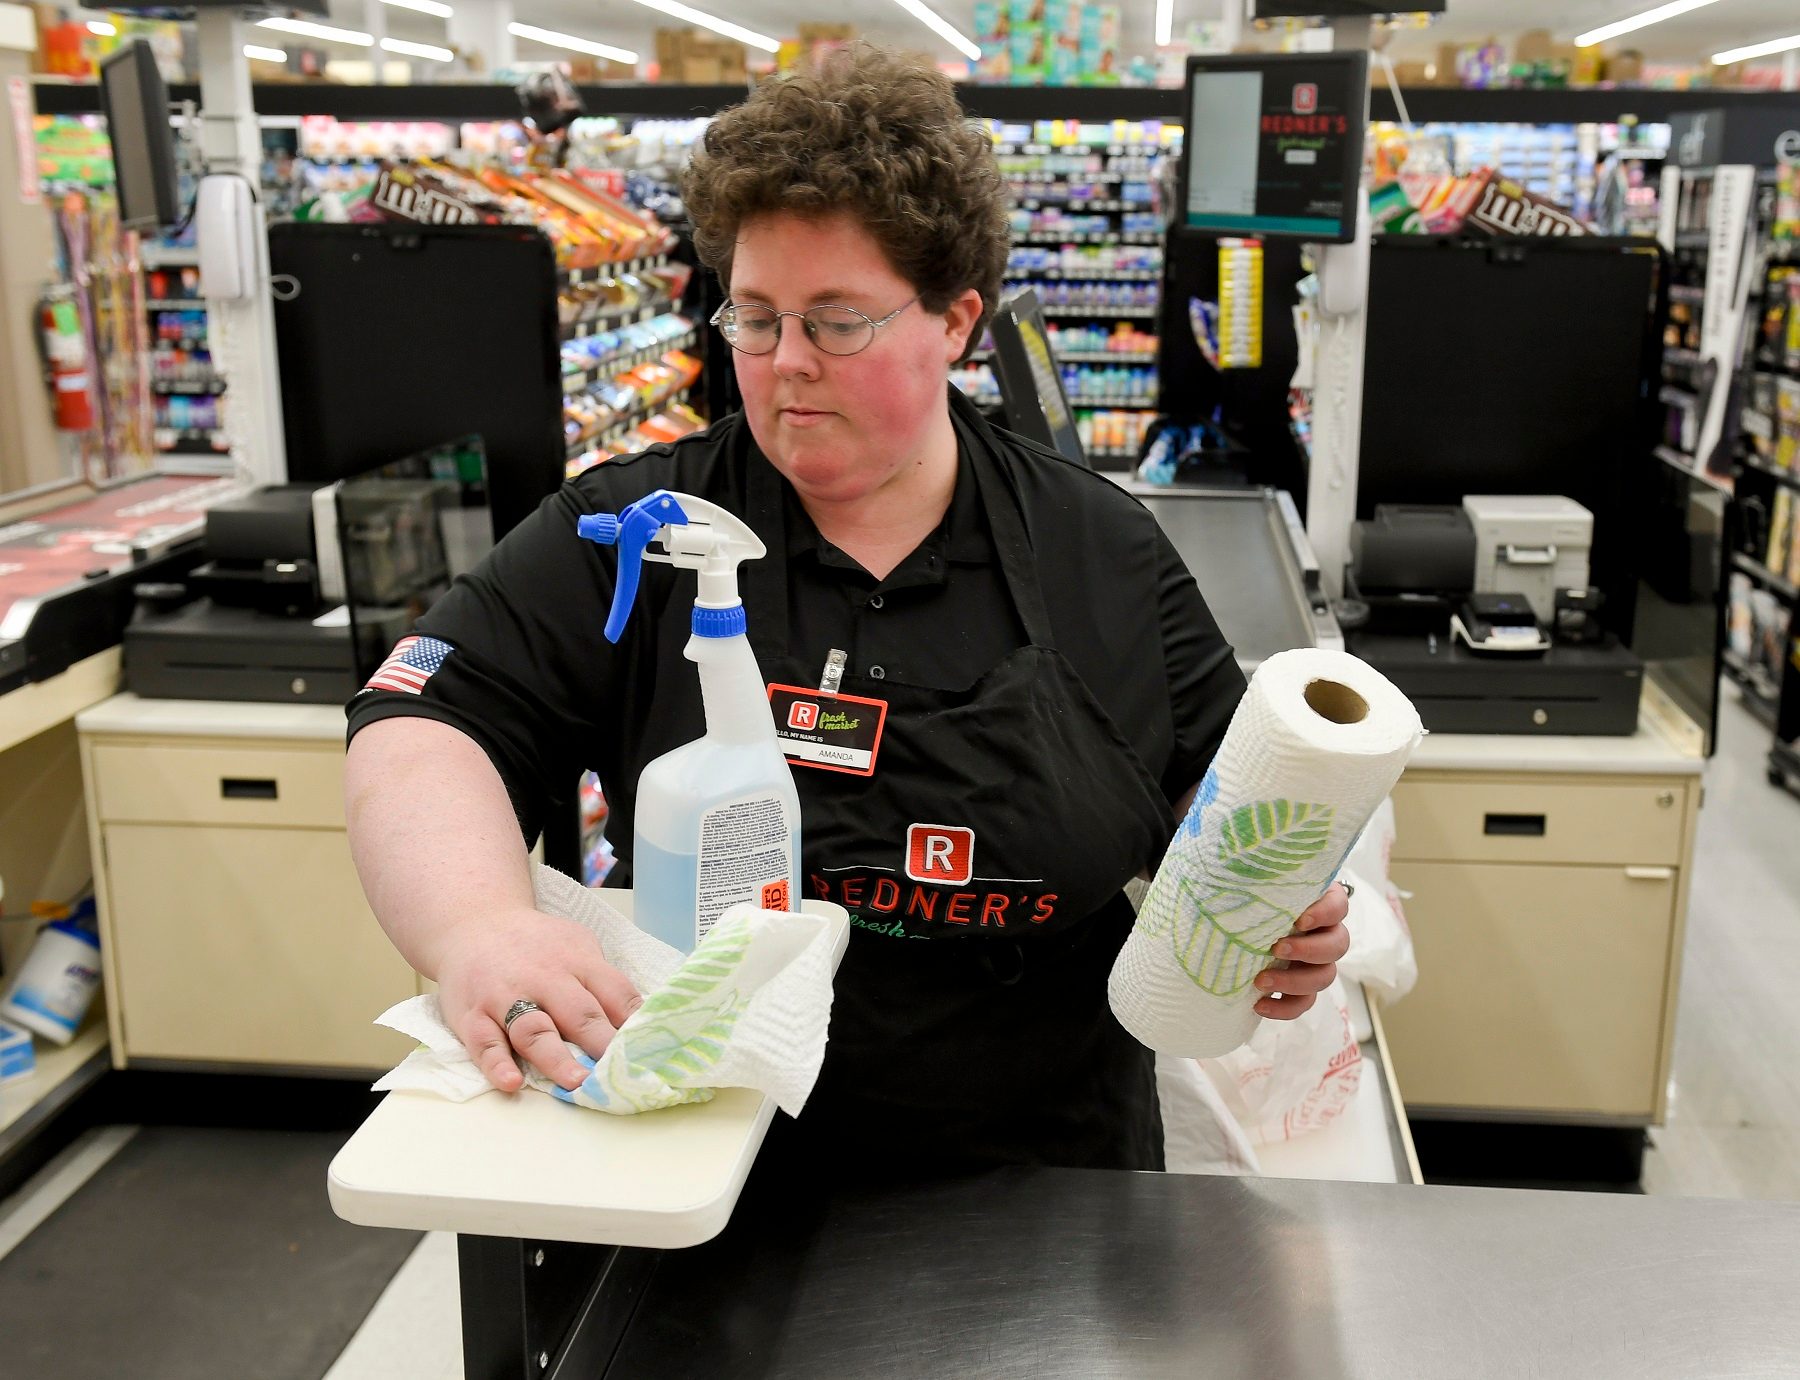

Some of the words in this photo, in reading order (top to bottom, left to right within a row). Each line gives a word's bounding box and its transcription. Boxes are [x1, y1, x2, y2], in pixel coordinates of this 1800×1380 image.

[796, 706, 811, 724] R
[819, 712, 846, 729] fresh
[824, 718, 860, 730] market
[799, 733, 817, 742] NAME
[818, 750, 854, 761] AMANDA
[923, 834, 954, 872] R
[811, 873, 1058, 927] REDNER'S
